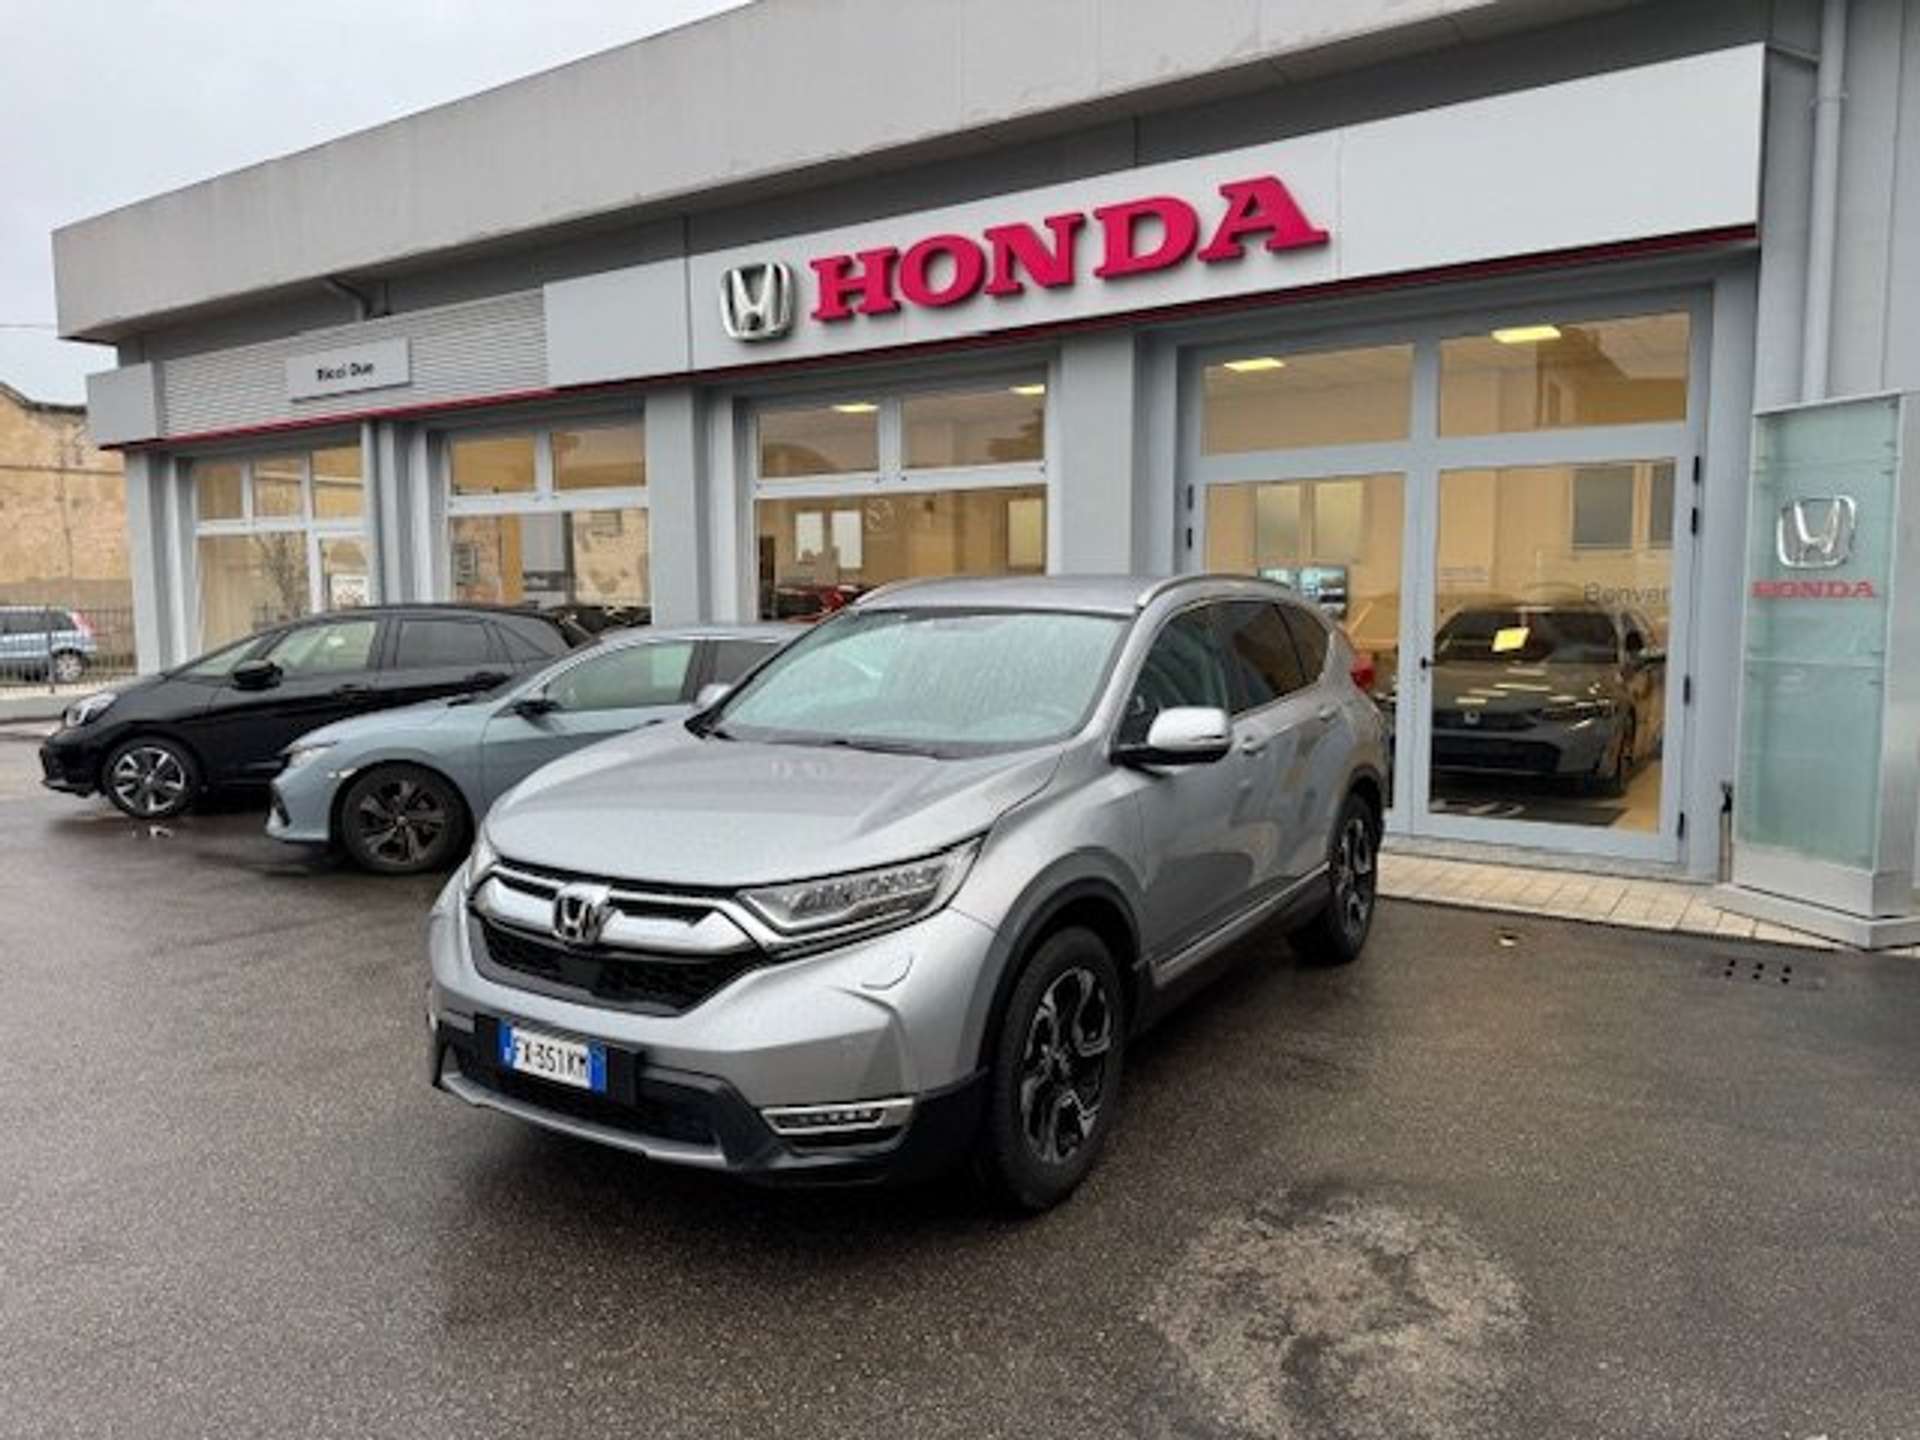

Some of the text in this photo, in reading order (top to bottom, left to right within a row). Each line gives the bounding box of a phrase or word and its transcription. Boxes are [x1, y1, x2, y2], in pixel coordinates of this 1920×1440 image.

[810, 175, 1330, 323] HONDA
[316, 362, 375, 381] Ricci Due
[1752, 580, 1877, 598] HONDA
